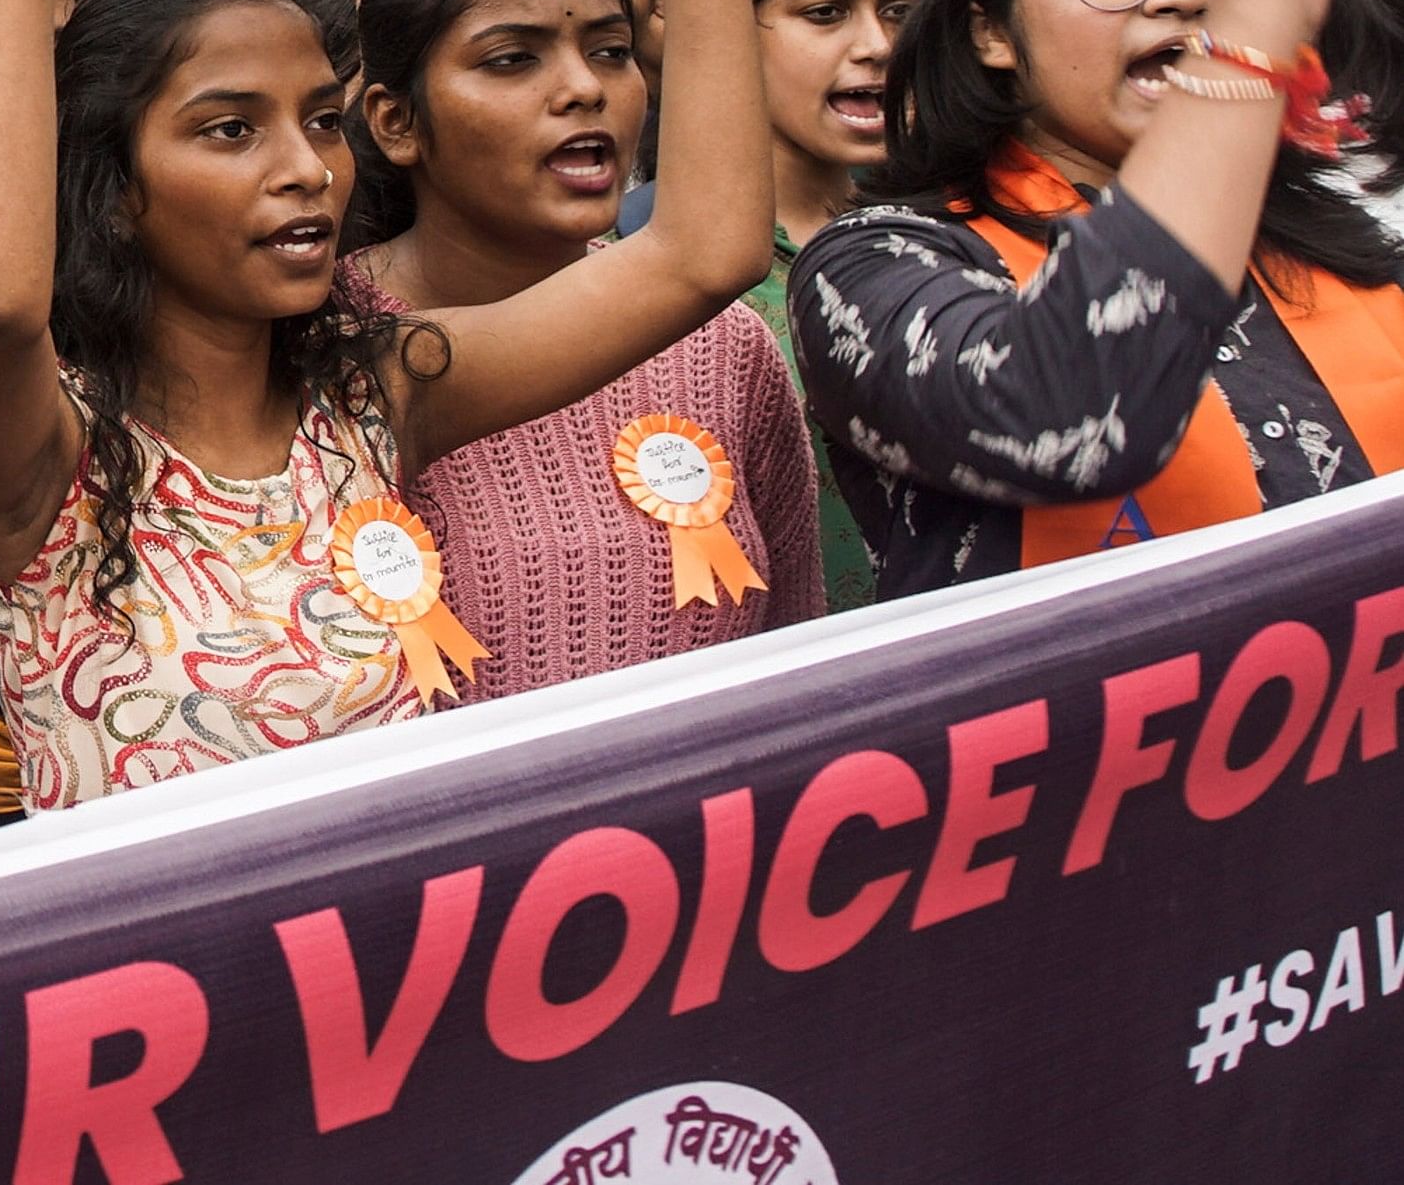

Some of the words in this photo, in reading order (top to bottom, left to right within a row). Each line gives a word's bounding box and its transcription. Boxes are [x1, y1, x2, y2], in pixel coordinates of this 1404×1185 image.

[272, 699, 1050, 1134] VOICE
[1060, 585, 1404, 878] FOR
[1187, 910, 1404, 1085] #SAV
